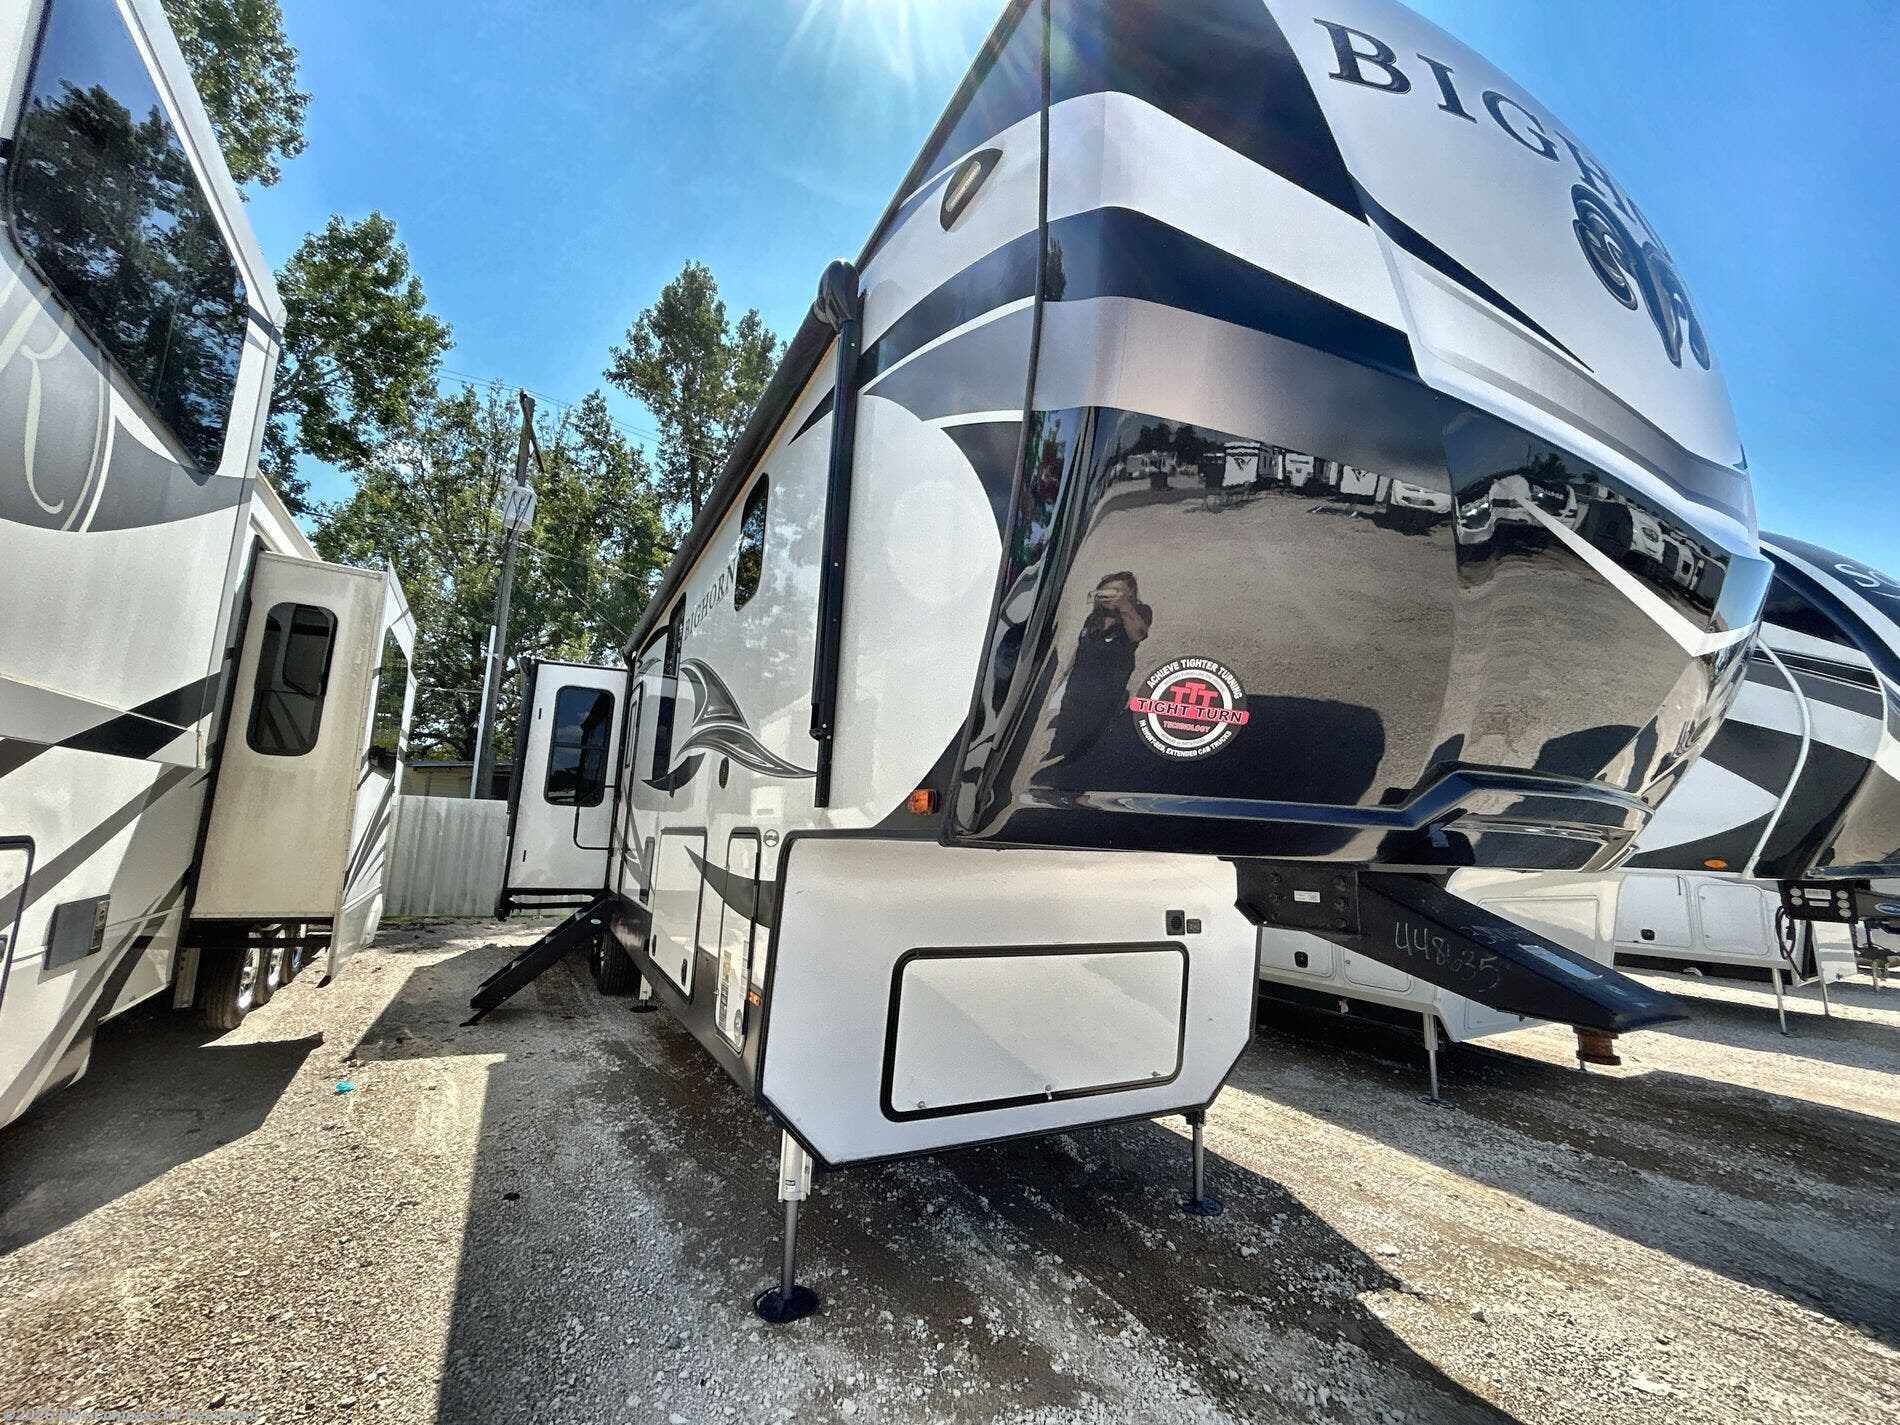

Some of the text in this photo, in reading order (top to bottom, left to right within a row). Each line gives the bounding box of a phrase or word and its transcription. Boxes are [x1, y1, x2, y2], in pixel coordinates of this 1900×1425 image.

[1313, 17, 1673, 264] BIGH
[684, 555, 739, 640] BIGHORN
[1147, 659, 1243, 700] ACHIEVE TIGHTER TURNING
[1138, 699, 1243, 723] TIGHT TURN
[1163, 720, 1211, 733] TECHNOLOGY
[1139, 719, 1145, 727] IN
[1166, 748, 1197, 757] EXTENDED
[1198, 746, 1211, 756] CAB
[1210, 730, 1232, 749] TRUCKS
